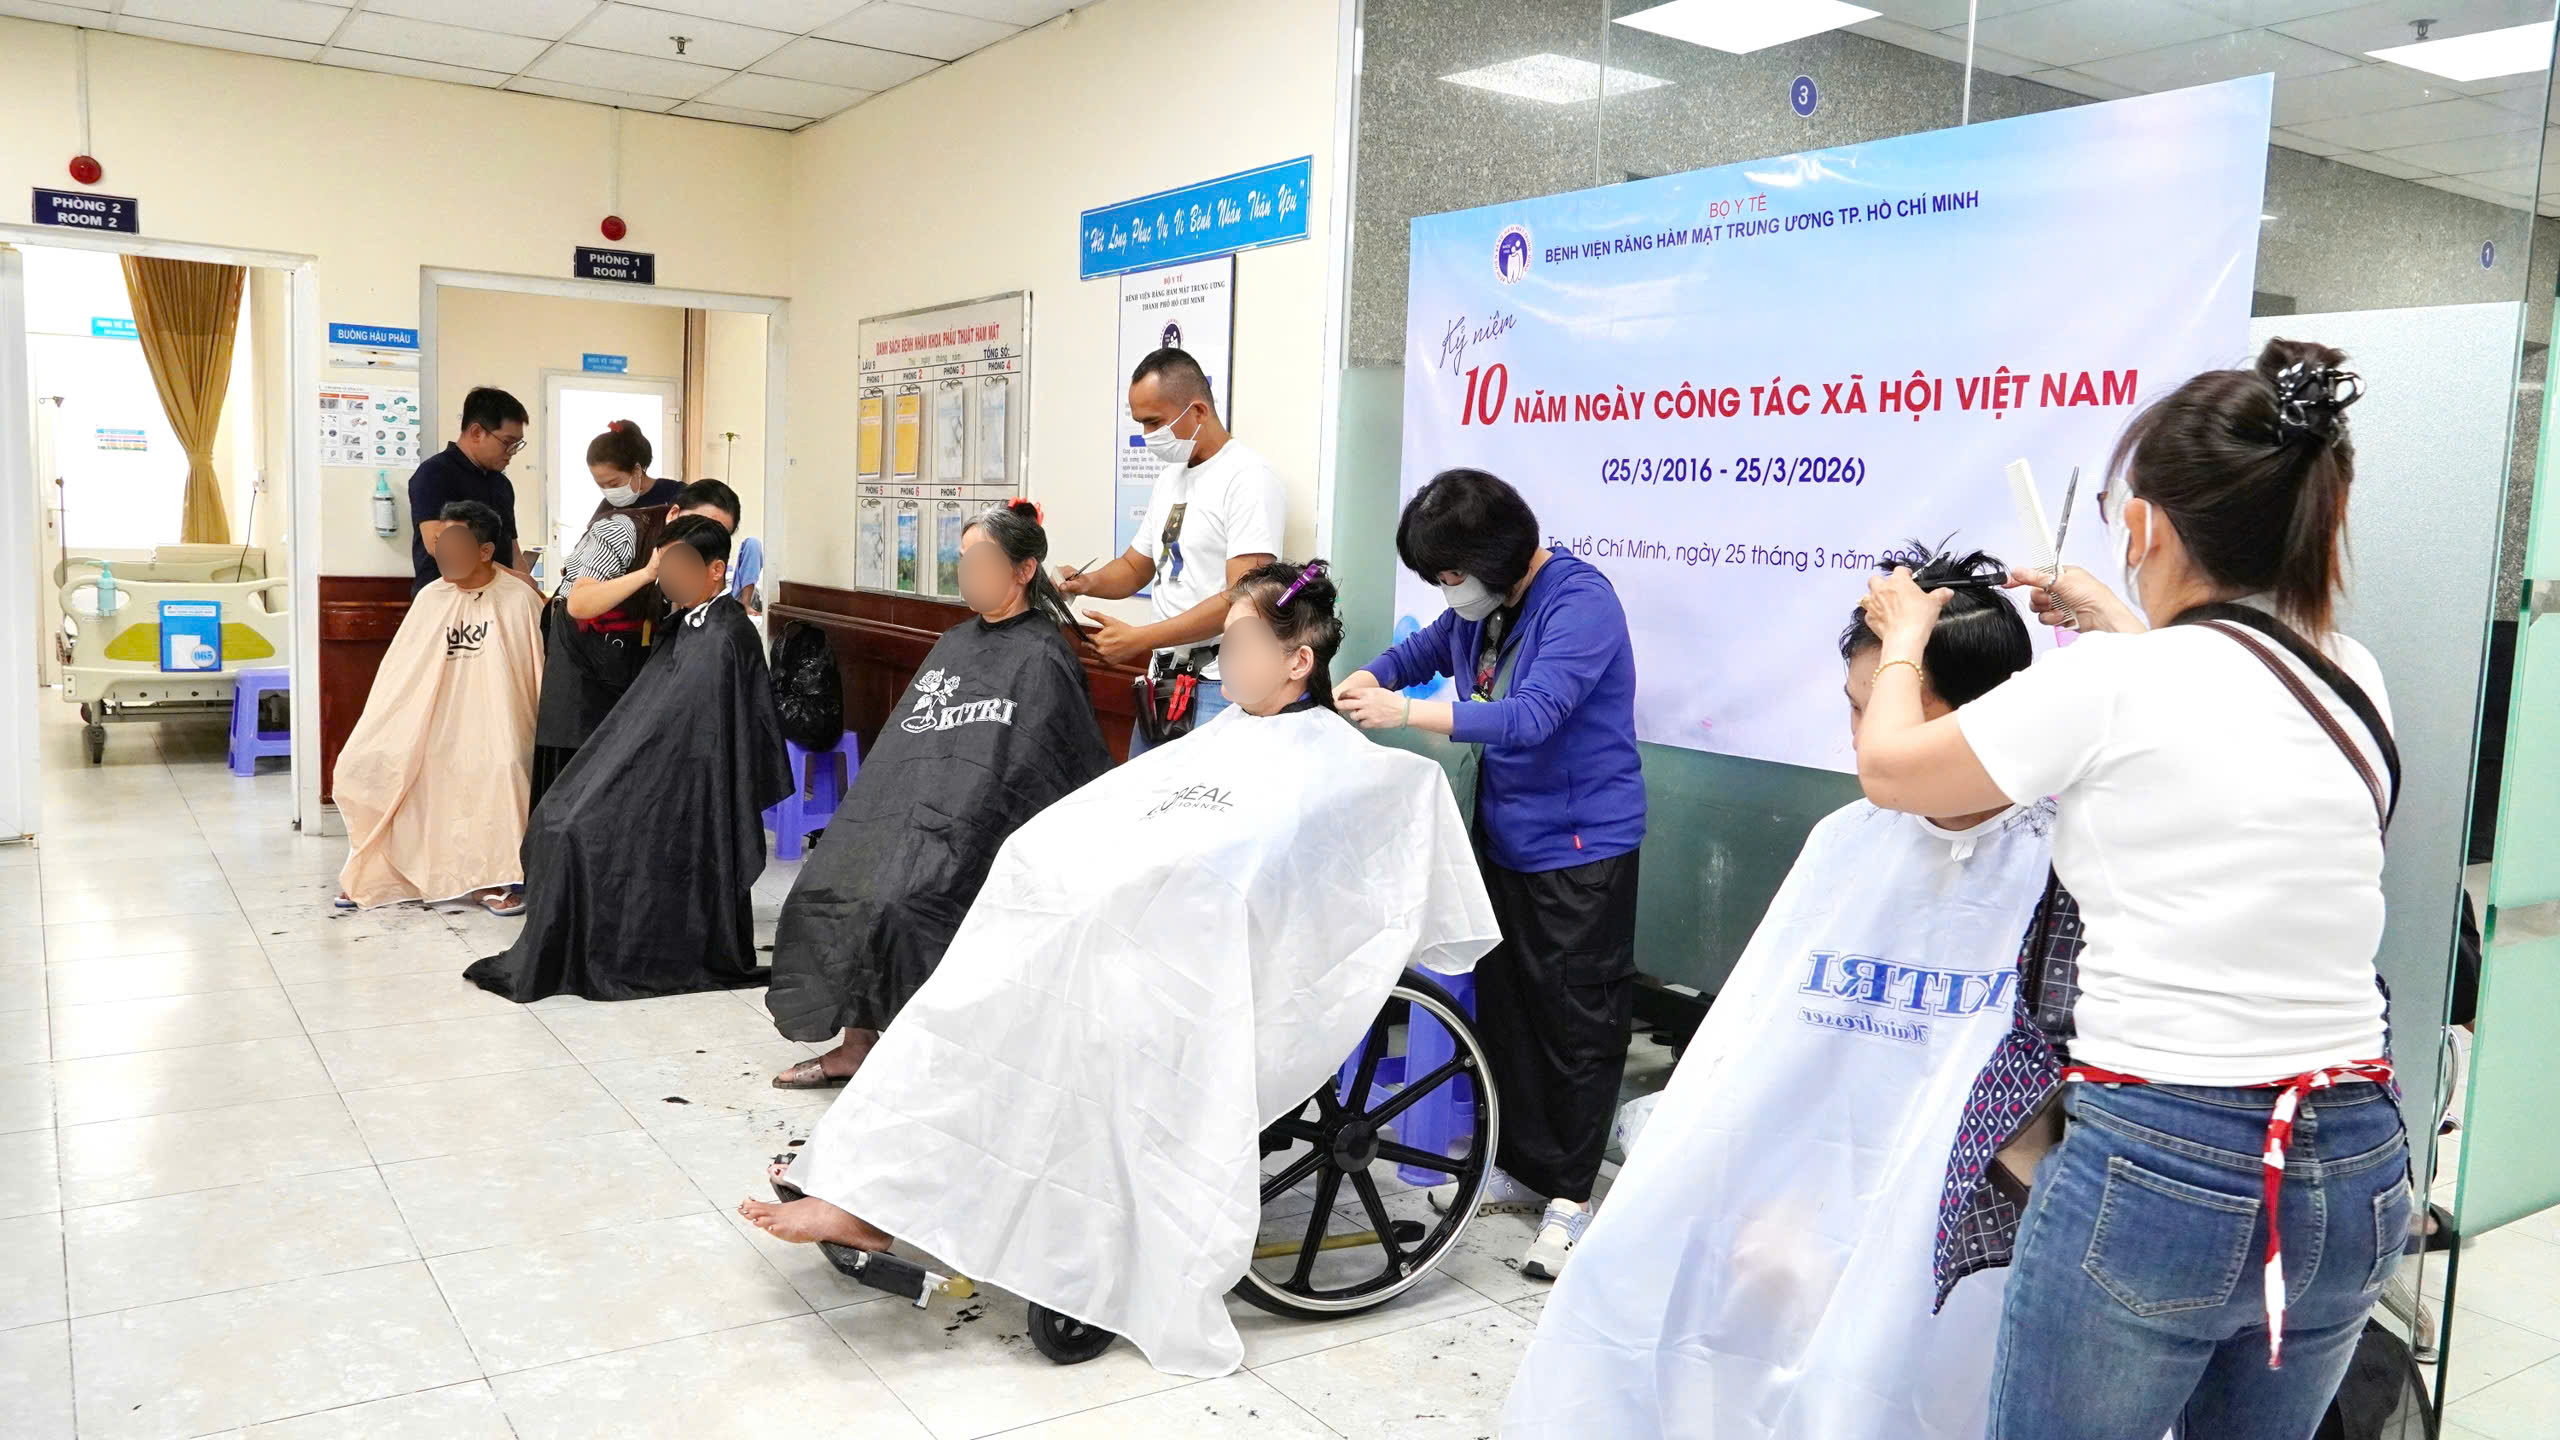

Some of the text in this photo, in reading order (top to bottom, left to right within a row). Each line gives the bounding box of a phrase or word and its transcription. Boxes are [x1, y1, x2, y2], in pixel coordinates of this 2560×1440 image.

[1799, 85, 1809, 105] 3
[52, 196, 121, 214] PHÒNG 2
[1190, 202, 1212, 240] Bệnh
[1217, 198, 1241, 229] Nhân
[1248, 190, 1271, 222] Thân
[1709, 192, 1767, 219] BỘ Y TẾ
[57, 212, 117, 228] ROOM 2
[1545, 190, 1979, 265] BỆNH VIỆN RĂNG HÀM MẶT TRUNG ƯƠNG TP. HỒ CHÍ MINH
[589, 253, 640, 267] PHÒNG 1
[593, 266, 637, 279] ROOM 1
[1190, 282, 1209, 293] TRUNG
[1190, 295, 1205, 305] MINH
[338, 328, 368, 341] BUỒNG
[369, 330, 387, 344] HẬU
[876, 340, 889, 356] DANH
[928, 332, 941, 350] KHOA
[1439, 310, 1517, 376] Kỷ niệm
[1461, 363, 2138, 425] 10 NĂM NGÀY CÔNG TÁC XÃ HỘI VIỆT NAM
[1601, 458, 1713, 485] (25/3/2016
[1735, 457, 1866, 487] 25/3/2026)
[1572, 535, 1593, 556] Hồ
[1597, 538, 1624, 557] Chí
[1628, 539, 1671, 561] Minh,
[1676, 542, 1721, 567] ngày
[1725, 544, 1746, 564] 25
[1752, 545, 1808, 572] tháng
[1814, 547, 1825, 568] 3
[1831, 549, 1875, 570] năm
[934, 697, 1018, 731] KITRI
